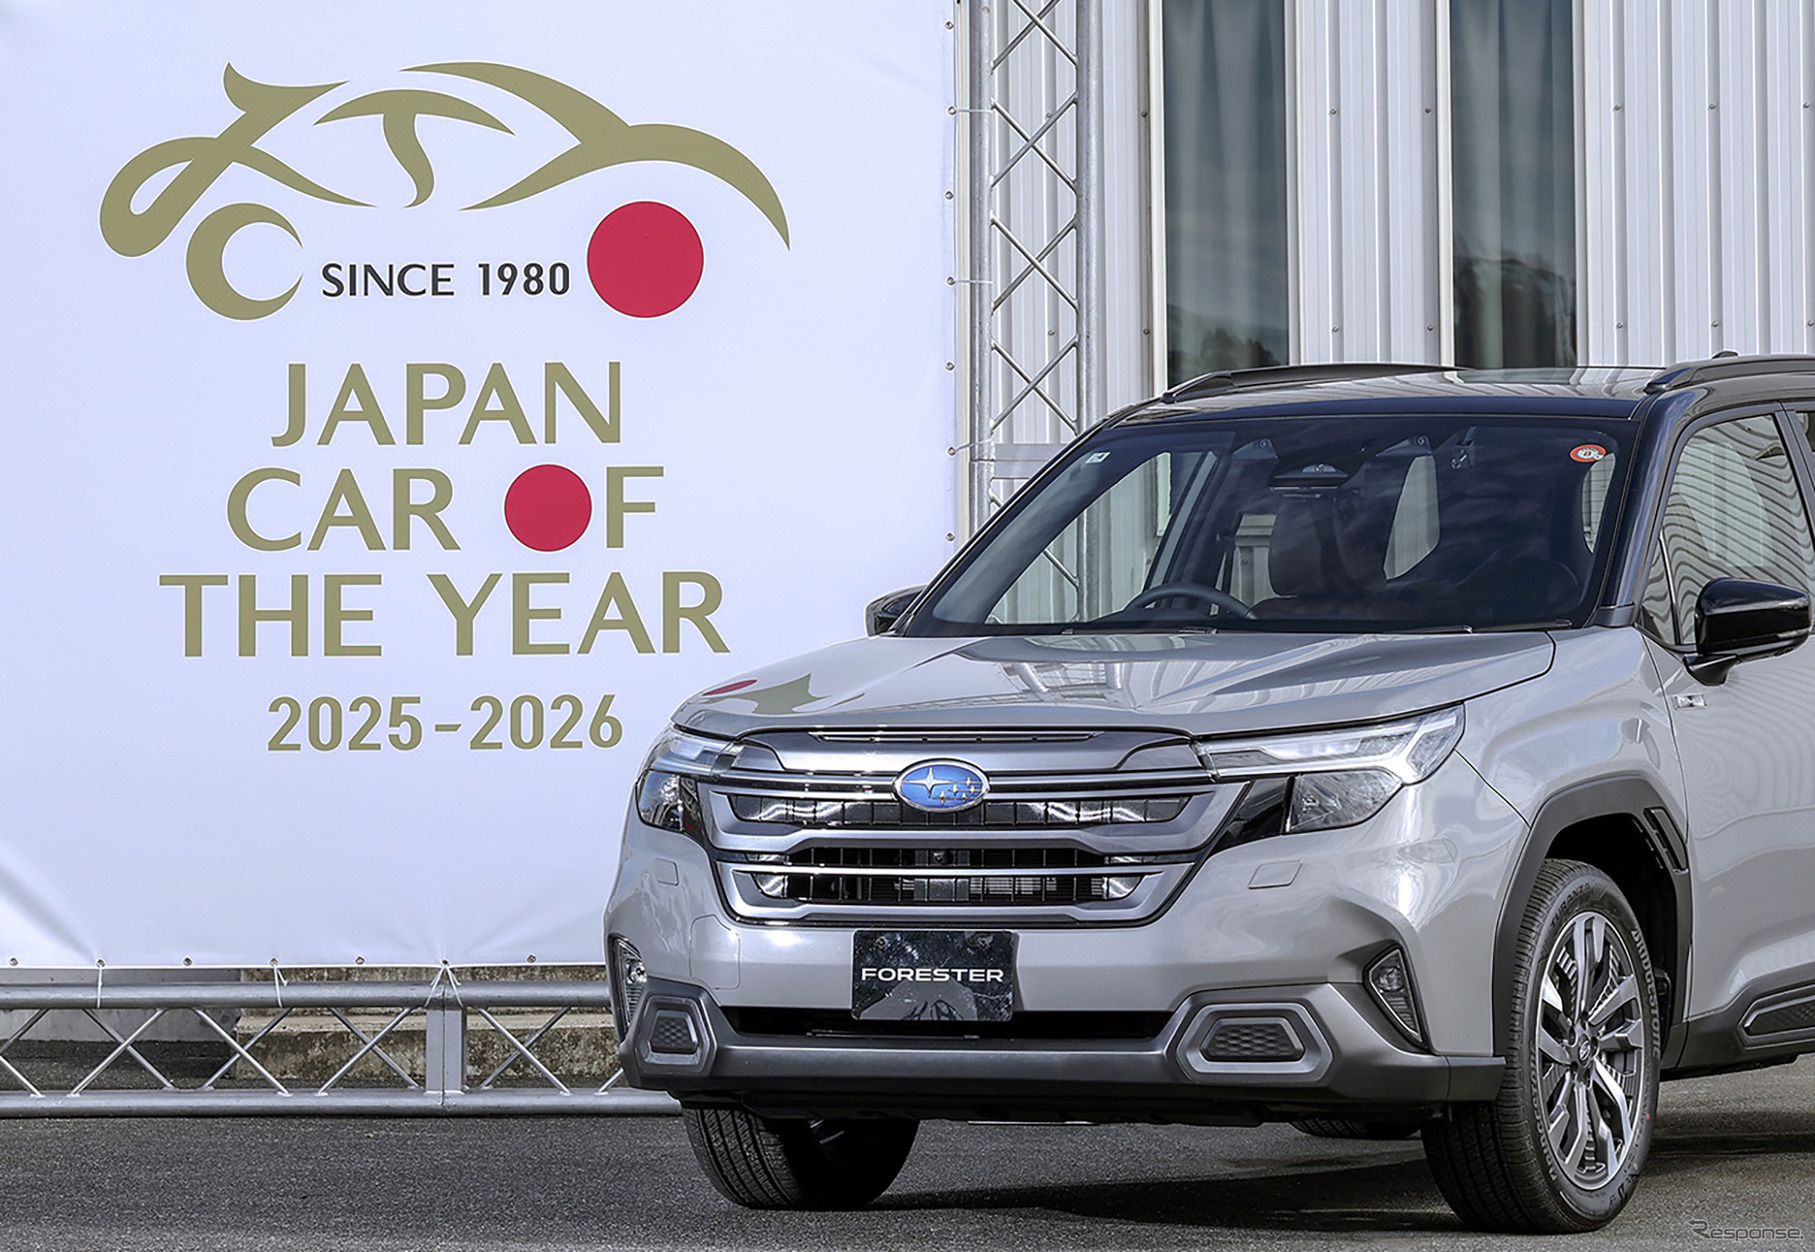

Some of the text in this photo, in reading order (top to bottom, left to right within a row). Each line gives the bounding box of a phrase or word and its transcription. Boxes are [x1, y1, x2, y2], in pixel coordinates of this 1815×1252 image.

[321, 262, 570, 298] SINCE 1980
[271, 361, 622, 447] JAPAN
[227, 467, 461, 552] CAR
[159, 571, 731, 658] THE YEAR
[267, 694, 623, 752] 2025-2026
[861, 967, 1004, 983] FORESTER
